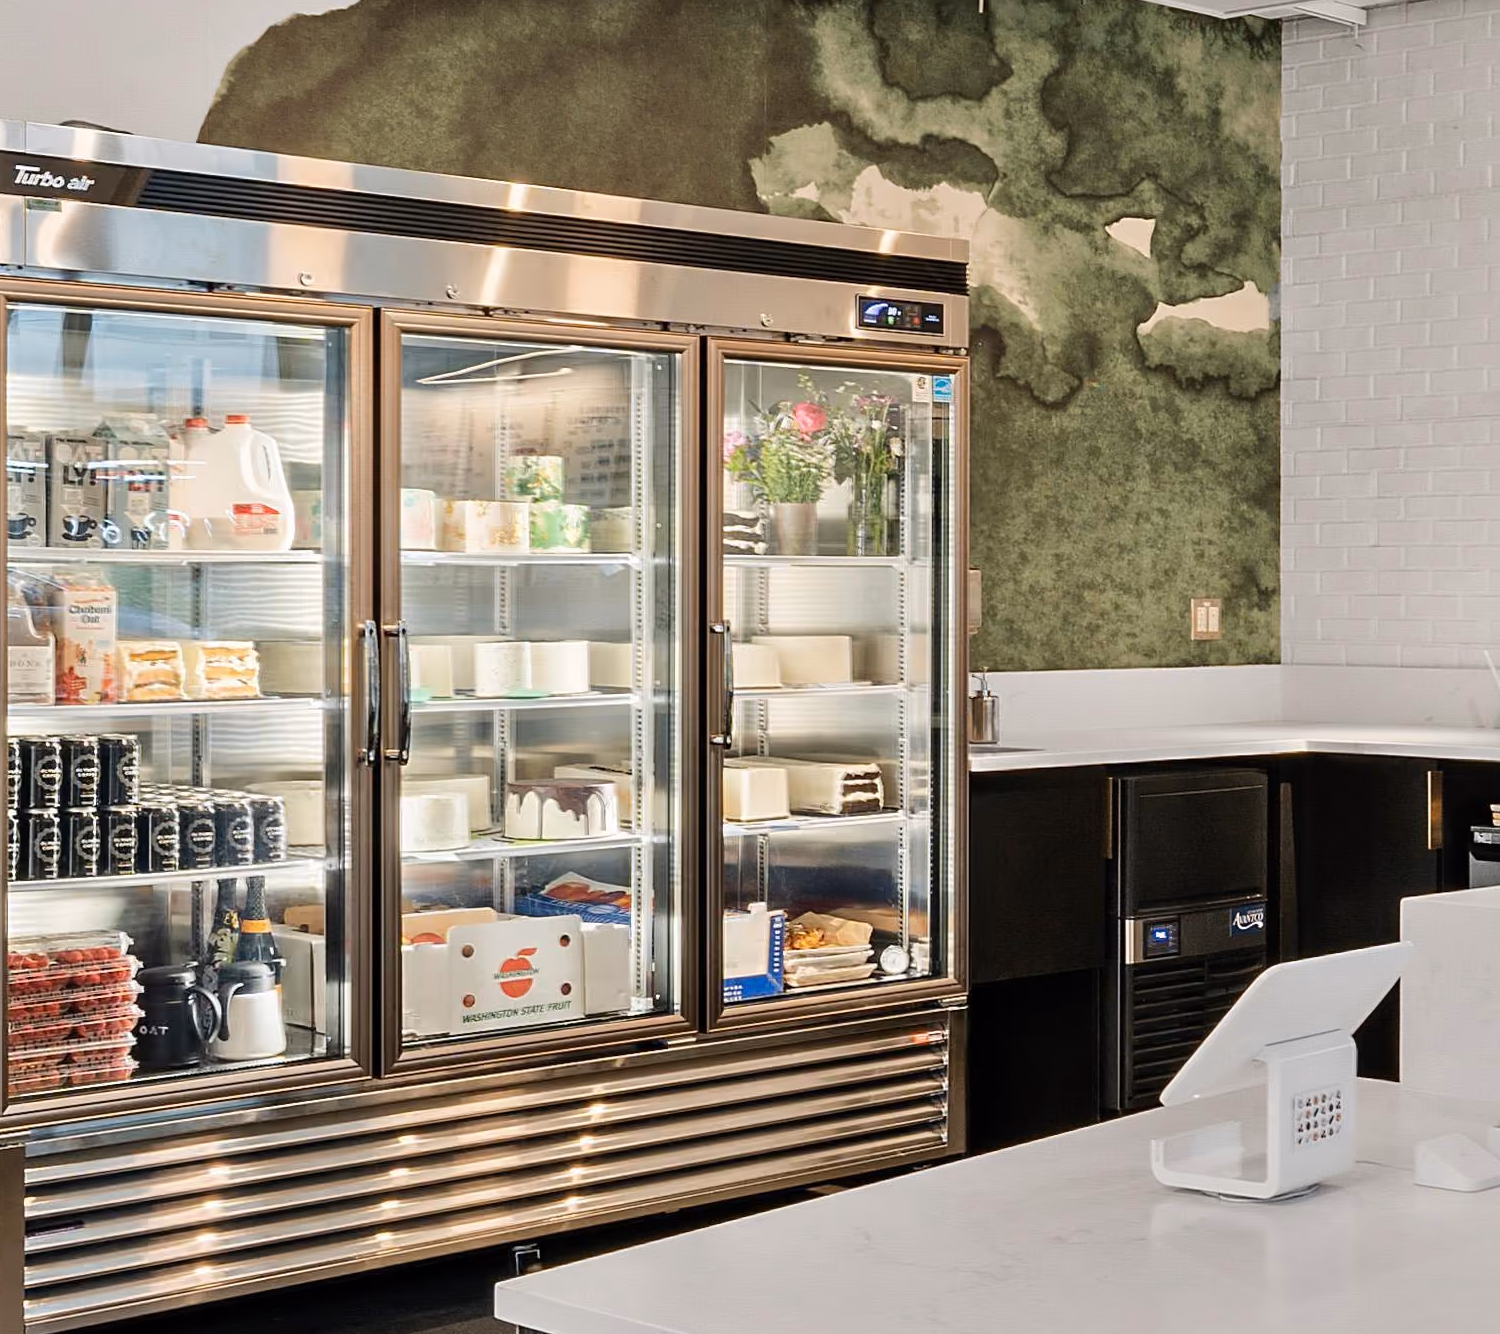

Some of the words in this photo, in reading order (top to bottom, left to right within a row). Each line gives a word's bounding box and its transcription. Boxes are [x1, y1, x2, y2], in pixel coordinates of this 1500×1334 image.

[14, 164, 65, 188] Turbo
[66, 175, 95, 191] air
[462, 1008, 519, 1024] WASHINGTON
[521, 1004, 545, 1016] STATE
[547, 1000, 572, 1013] FRUIT
[139, 1025, 169, 1036] OAT
